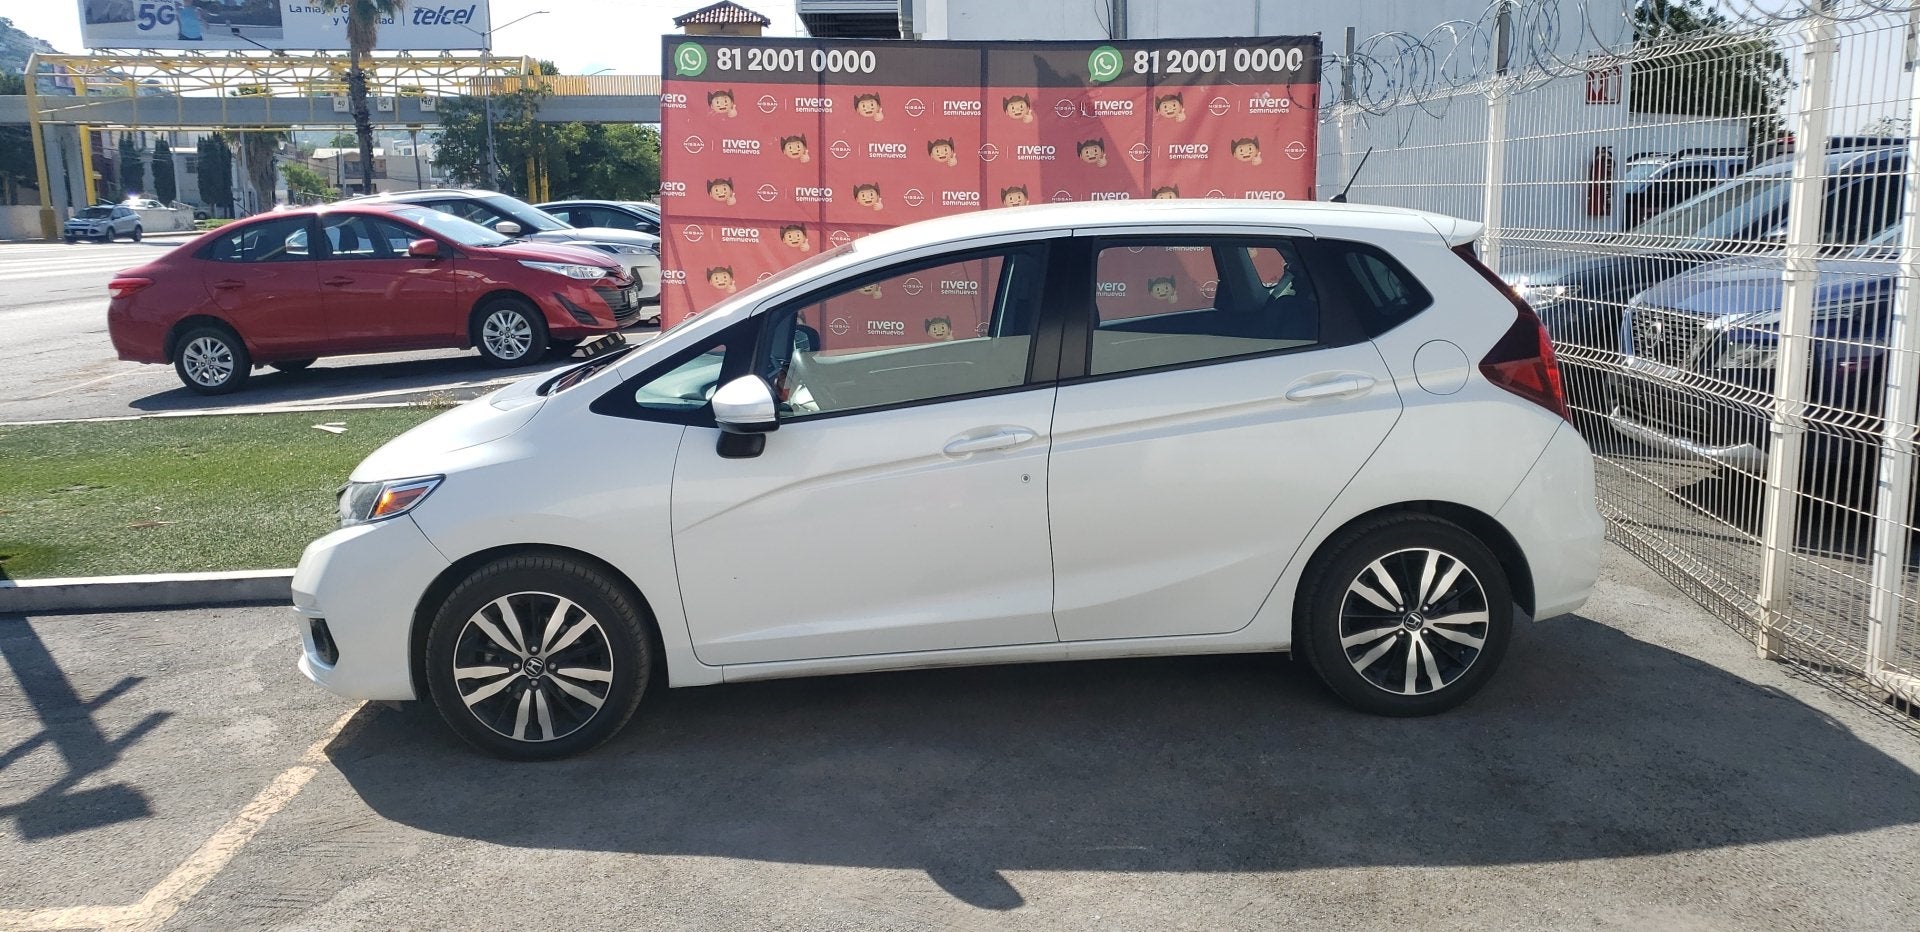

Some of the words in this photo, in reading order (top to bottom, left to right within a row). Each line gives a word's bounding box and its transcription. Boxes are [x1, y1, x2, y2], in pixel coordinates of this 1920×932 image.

[289, 5, 302, 13] La
[305, 6, 338, 15] mayr
[413, 4, 477, 25] telcel
[138, 4, 175, 30] 5G
[717, 48, 740, 70] 81
[748, 49, 804, 71] 2001
[811, 50, 876, 73] 0000
[1134, 50, 1159, 74] 81
[1167, 49, 1226, 73] 2001
[1234, 48, 1303, 72] 0000
[795, 97, 832, 107] rivero
[944, 100, 981, 110] rivero
[1094, 100, 1133, 110] rivero
[1249, 98, 1289, 108] rivero
[722, 139, 760, 149] rivero
[869, 143, 906, 153] rivero
[1169, 143, 1208, 154] rivero
[1017, 145, 1055, 155] rivero
[795, 187, 832, 197] rivero
[943, 191, 980, 201] rivero
[1091, 191, 1129, 200] rivero
[1245, 190, 1285, 200] rivero
[722, 227, 759, 237] rivero
[941, 280, 978, 290] rivero
[867, 320, 904, 330] rivero
